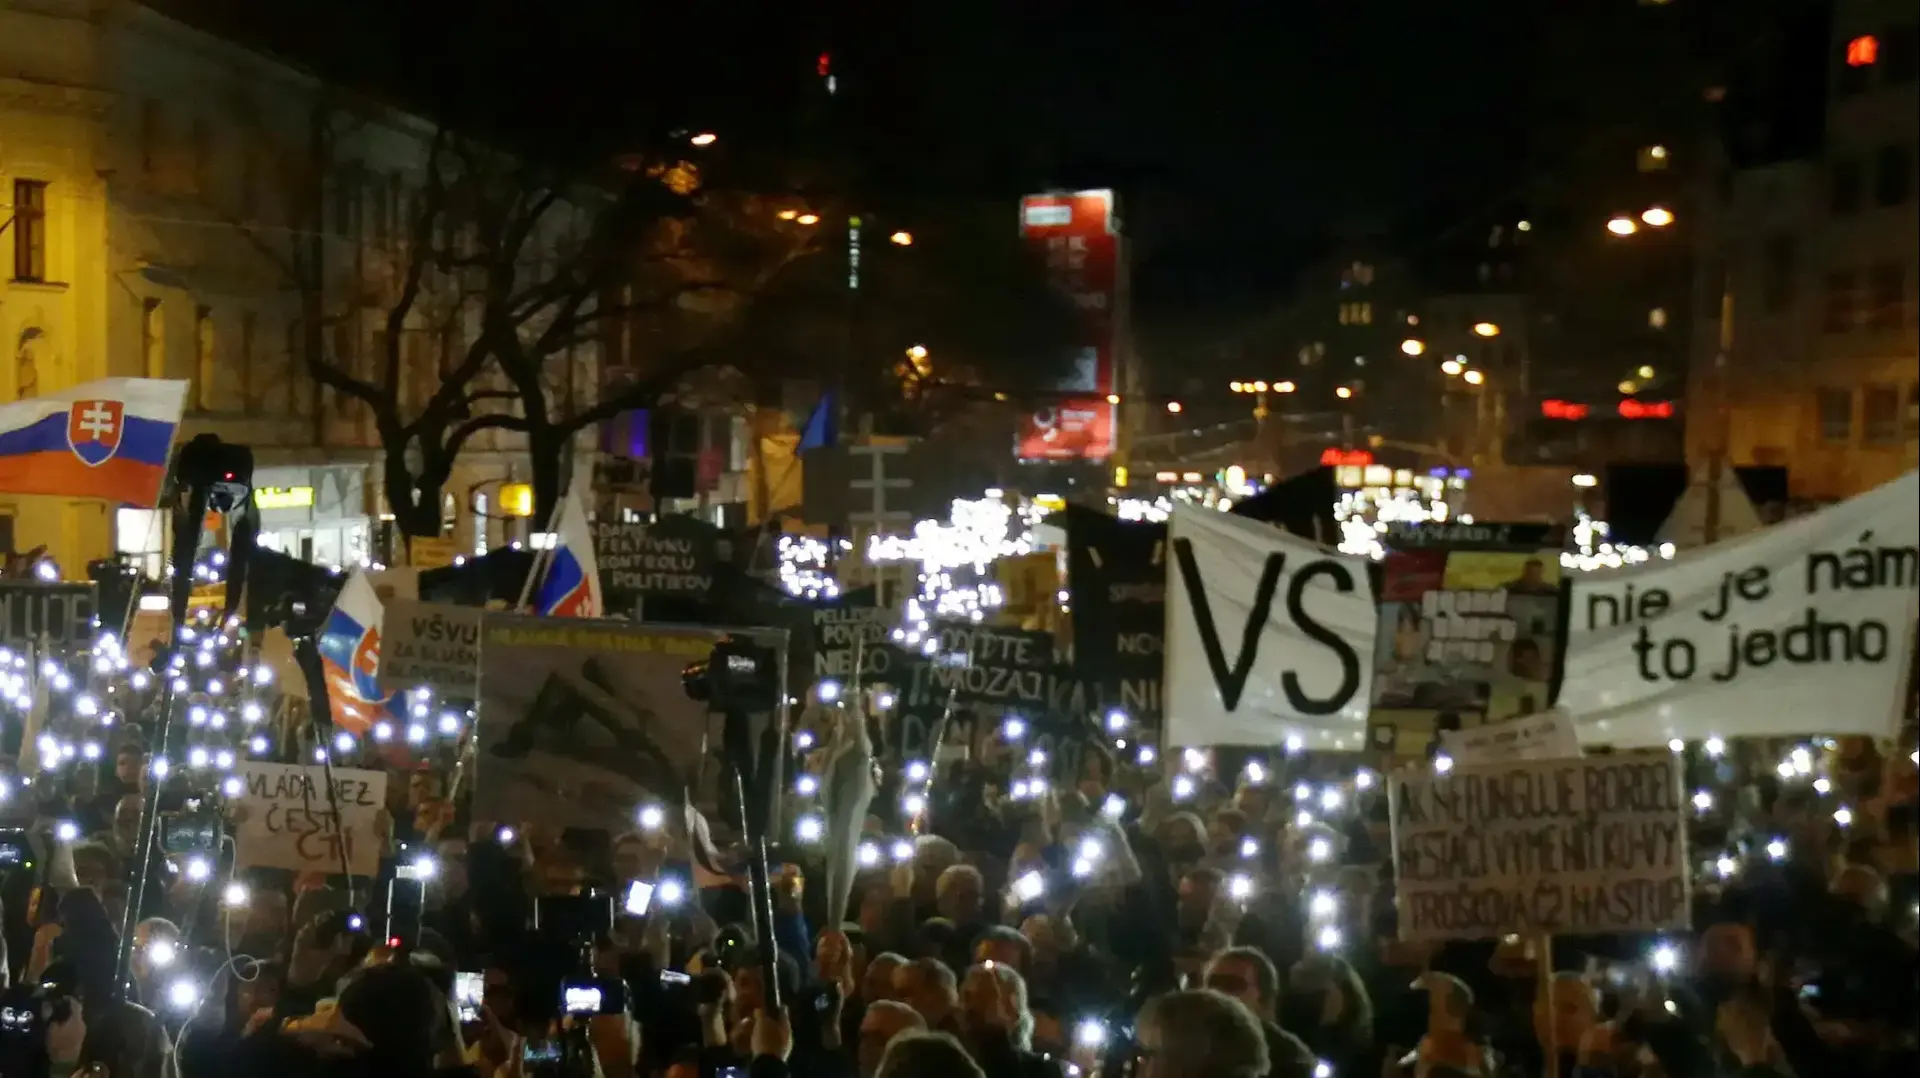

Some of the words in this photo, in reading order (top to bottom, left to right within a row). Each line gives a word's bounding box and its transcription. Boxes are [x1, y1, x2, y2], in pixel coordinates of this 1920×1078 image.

[1587, 583, 1670, 630] nie
[1700, 565, 1771, 622] je
[1807, 529, 1917, 594] nám
[1173, 536, 1360, 716] VS
[1632, 624, 1696, 682] to
[1711, 607, 1889, 682] jedno
[245, 768, 317, 801] VLÁDA
